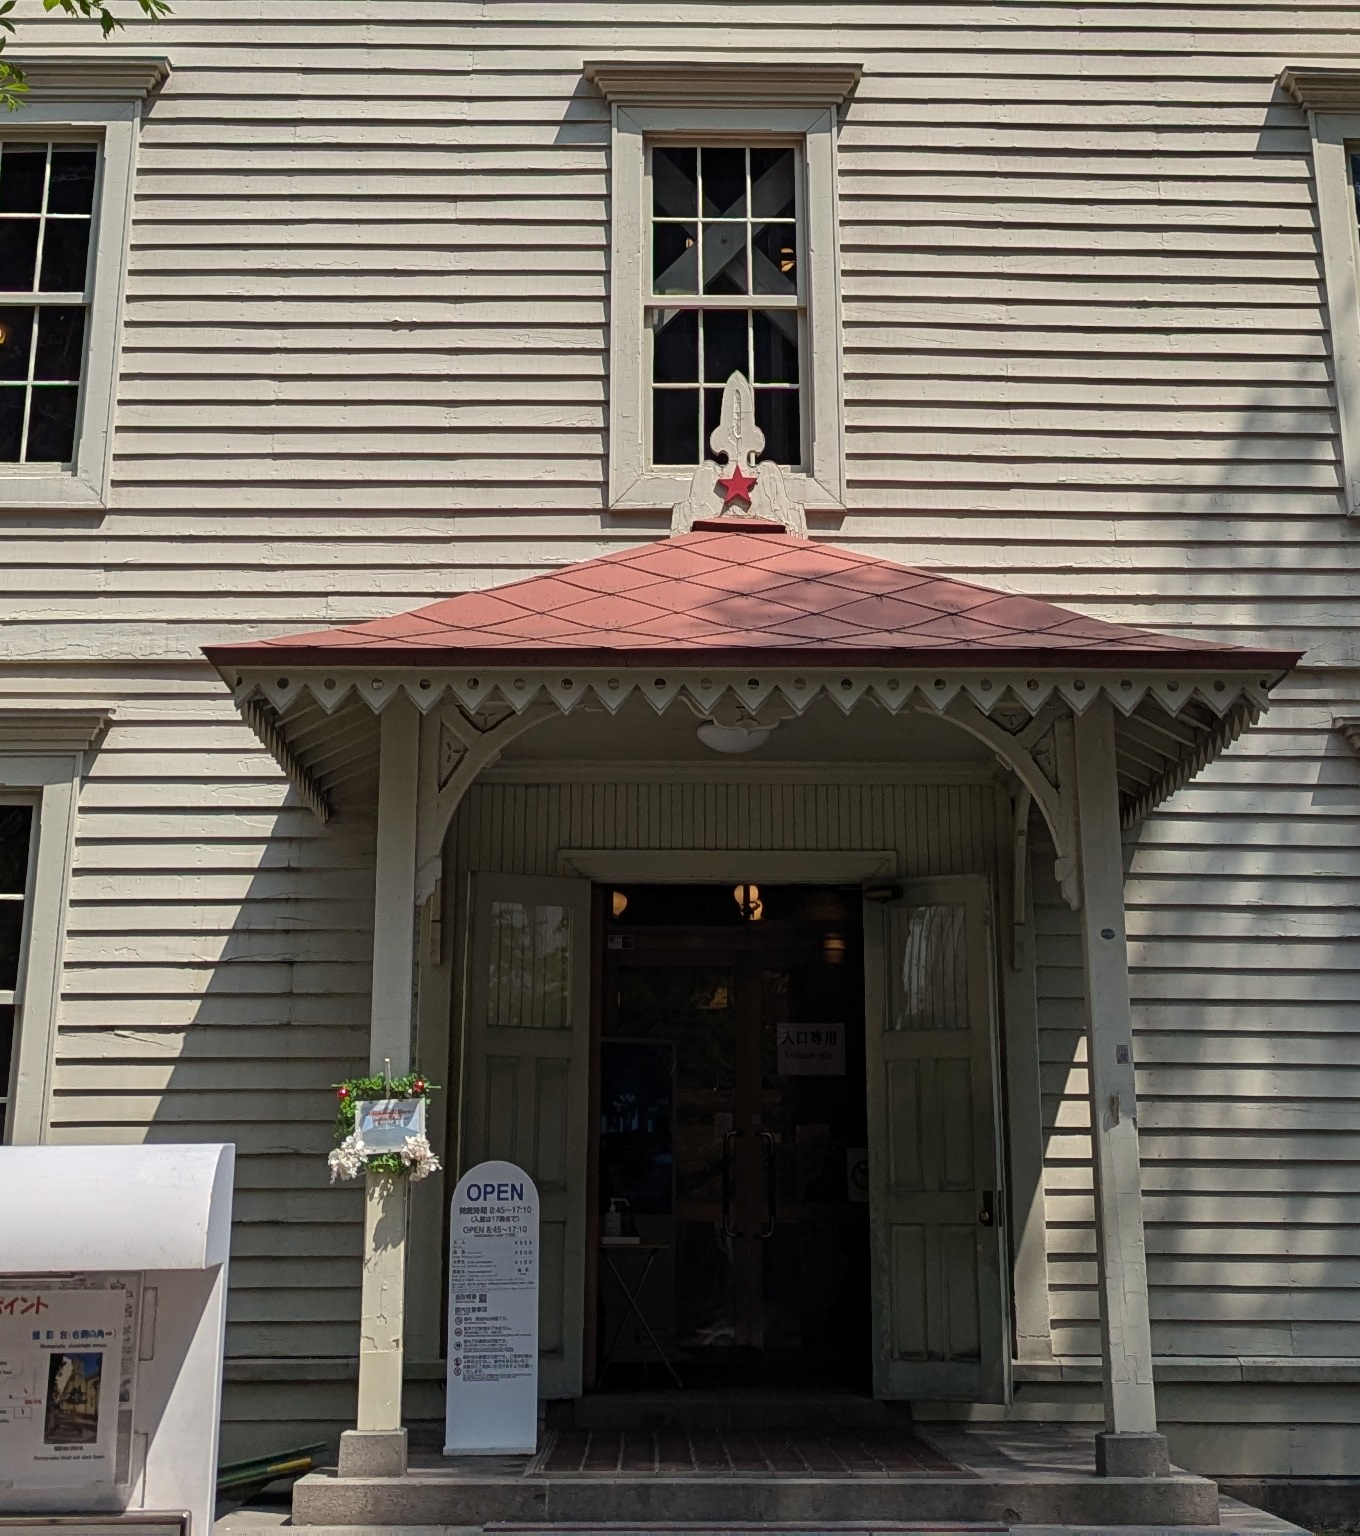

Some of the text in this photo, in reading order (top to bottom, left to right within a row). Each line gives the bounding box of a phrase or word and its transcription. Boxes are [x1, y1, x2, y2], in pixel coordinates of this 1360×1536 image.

[781, 1030, 837, 1046] 入口専用
[467, 1183, 524, 1202] OPEN
